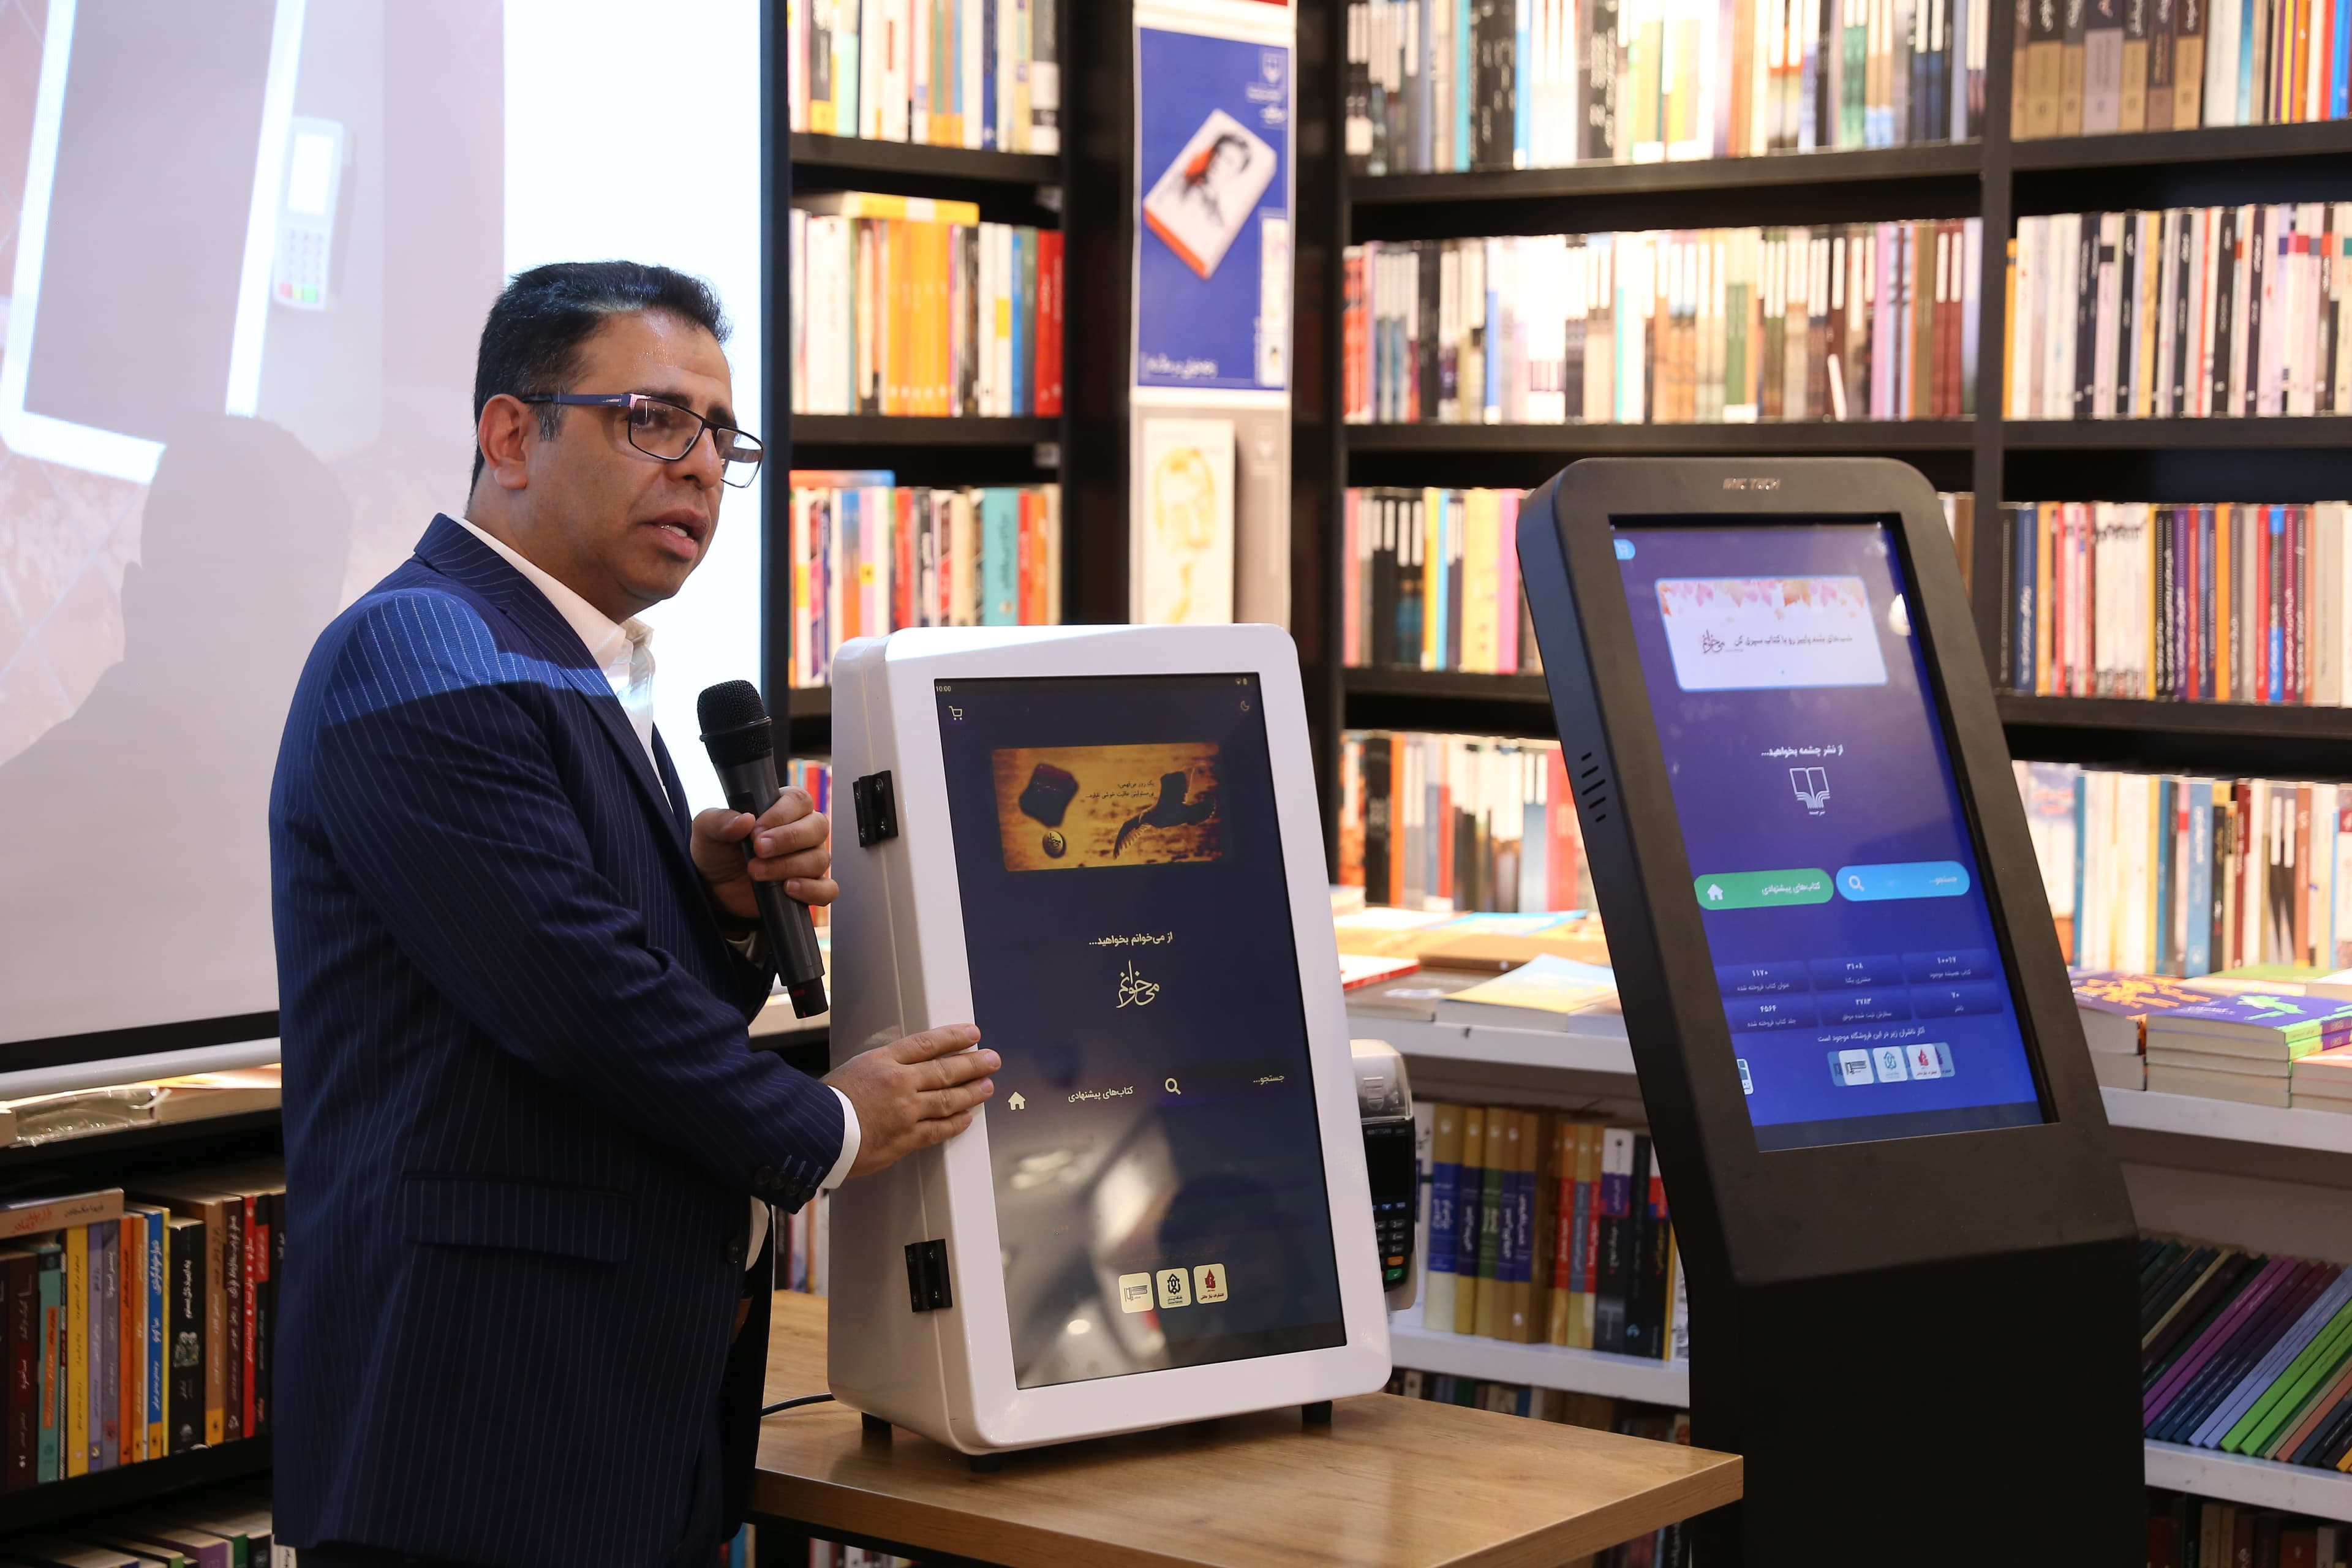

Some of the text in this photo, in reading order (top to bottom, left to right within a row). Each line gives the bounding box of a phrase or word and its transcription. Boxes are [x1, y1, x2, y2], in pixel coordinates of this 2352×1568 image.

[1798, 746, 1822, 758] چشمه
[1823, 745, 1836, 757] نشر
[1761, 884, 1793, 896] پیشنهادی
[1131, 934, 1166, 946] می‌خوانم
[1167, 932, 1174, 943] از
[1068, 1086, 1134, 1103] کتاب‌های پیشنهادی
